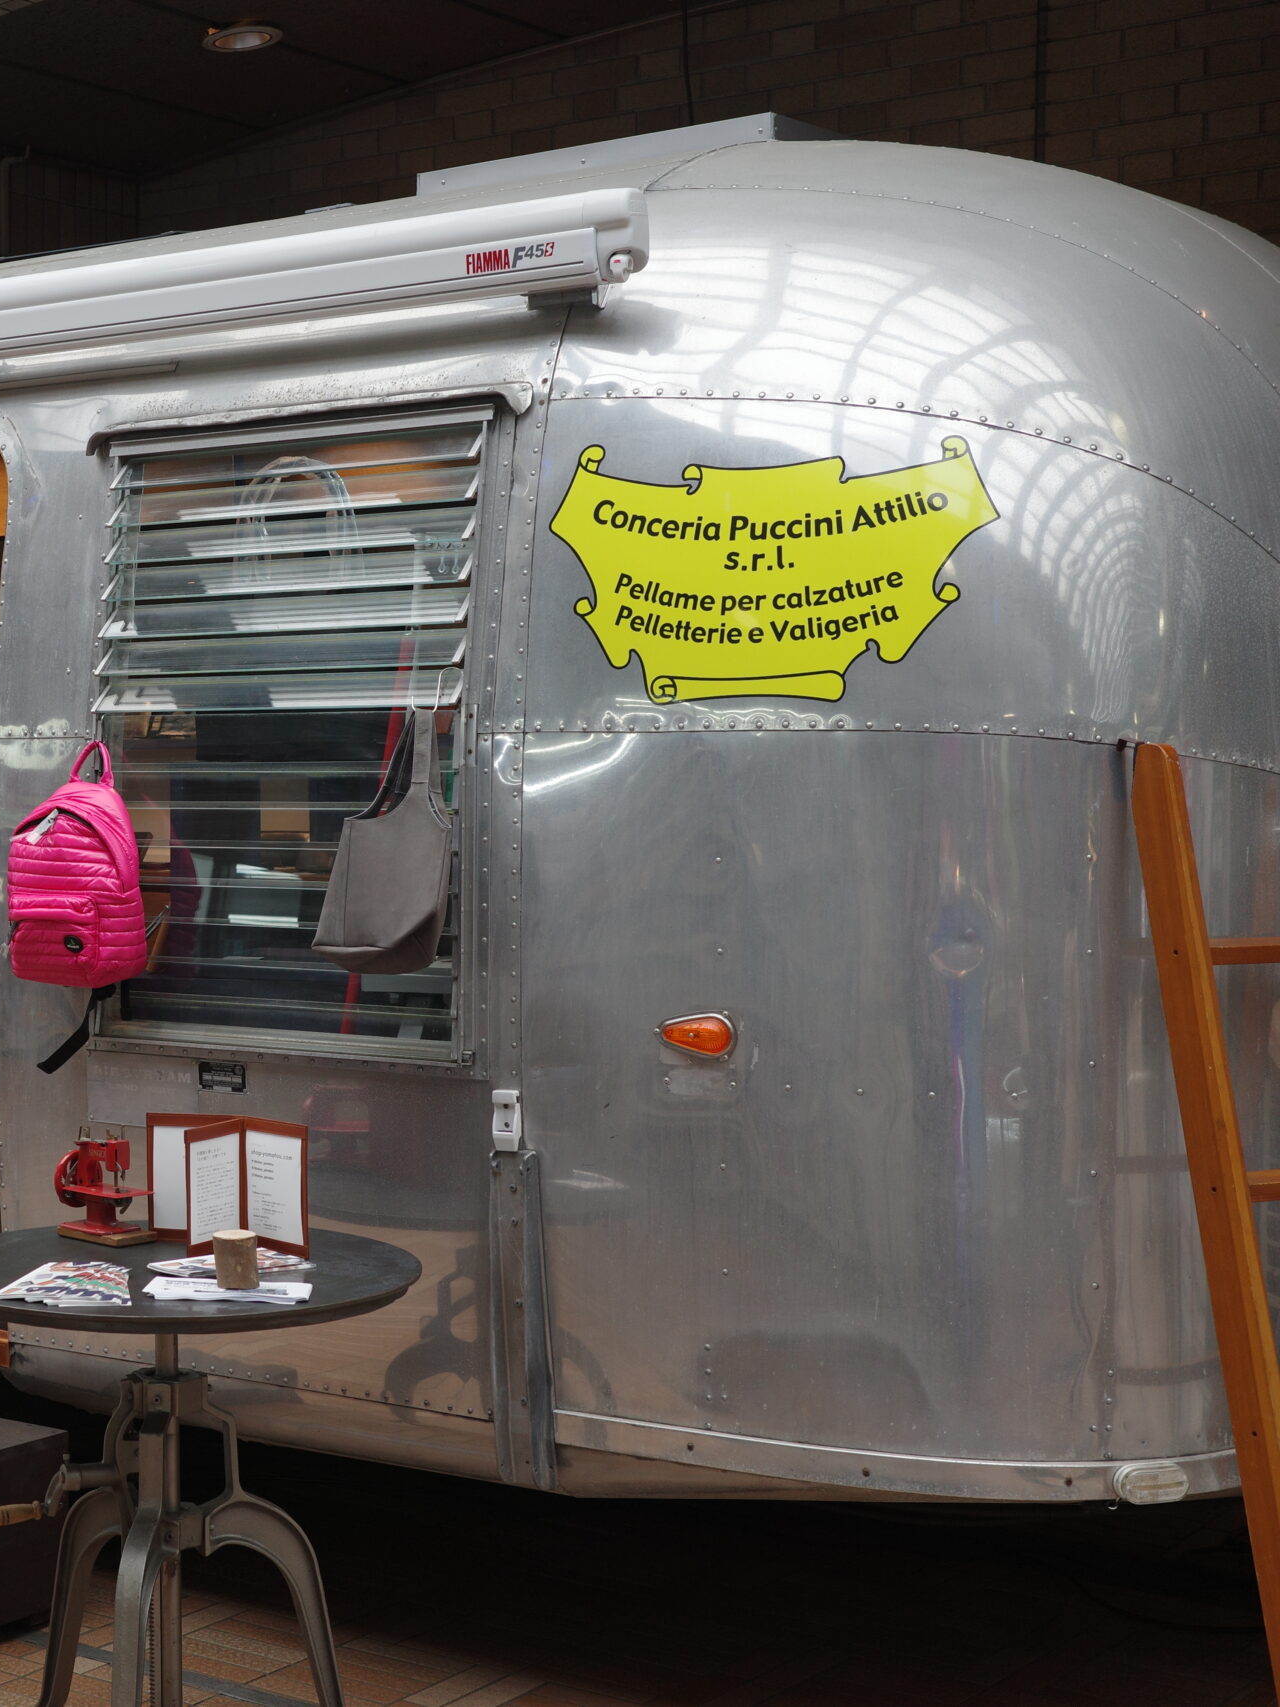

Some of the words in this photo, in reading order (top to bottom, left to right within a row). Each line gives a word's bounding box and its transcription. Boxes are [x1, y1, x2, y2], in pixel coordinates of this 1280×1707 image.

[466, 249, 511, 275] FIAMMA
[593, 499, 722, 542] Conceria
[728, 508, 845, 542] Puccini
[851, 491, 950, 533] Attilio
[723, 545, 796, 571] s.r.l.
[614, 573, 716, 612] Pellame
[721, 592, 766, 617] per
[772, 570, 904, 611] calzature
[614, 604, 743, 645] Pelletterie
[747, 627, 765, 645] e
[770, 603, 900, 644] Valigeria
